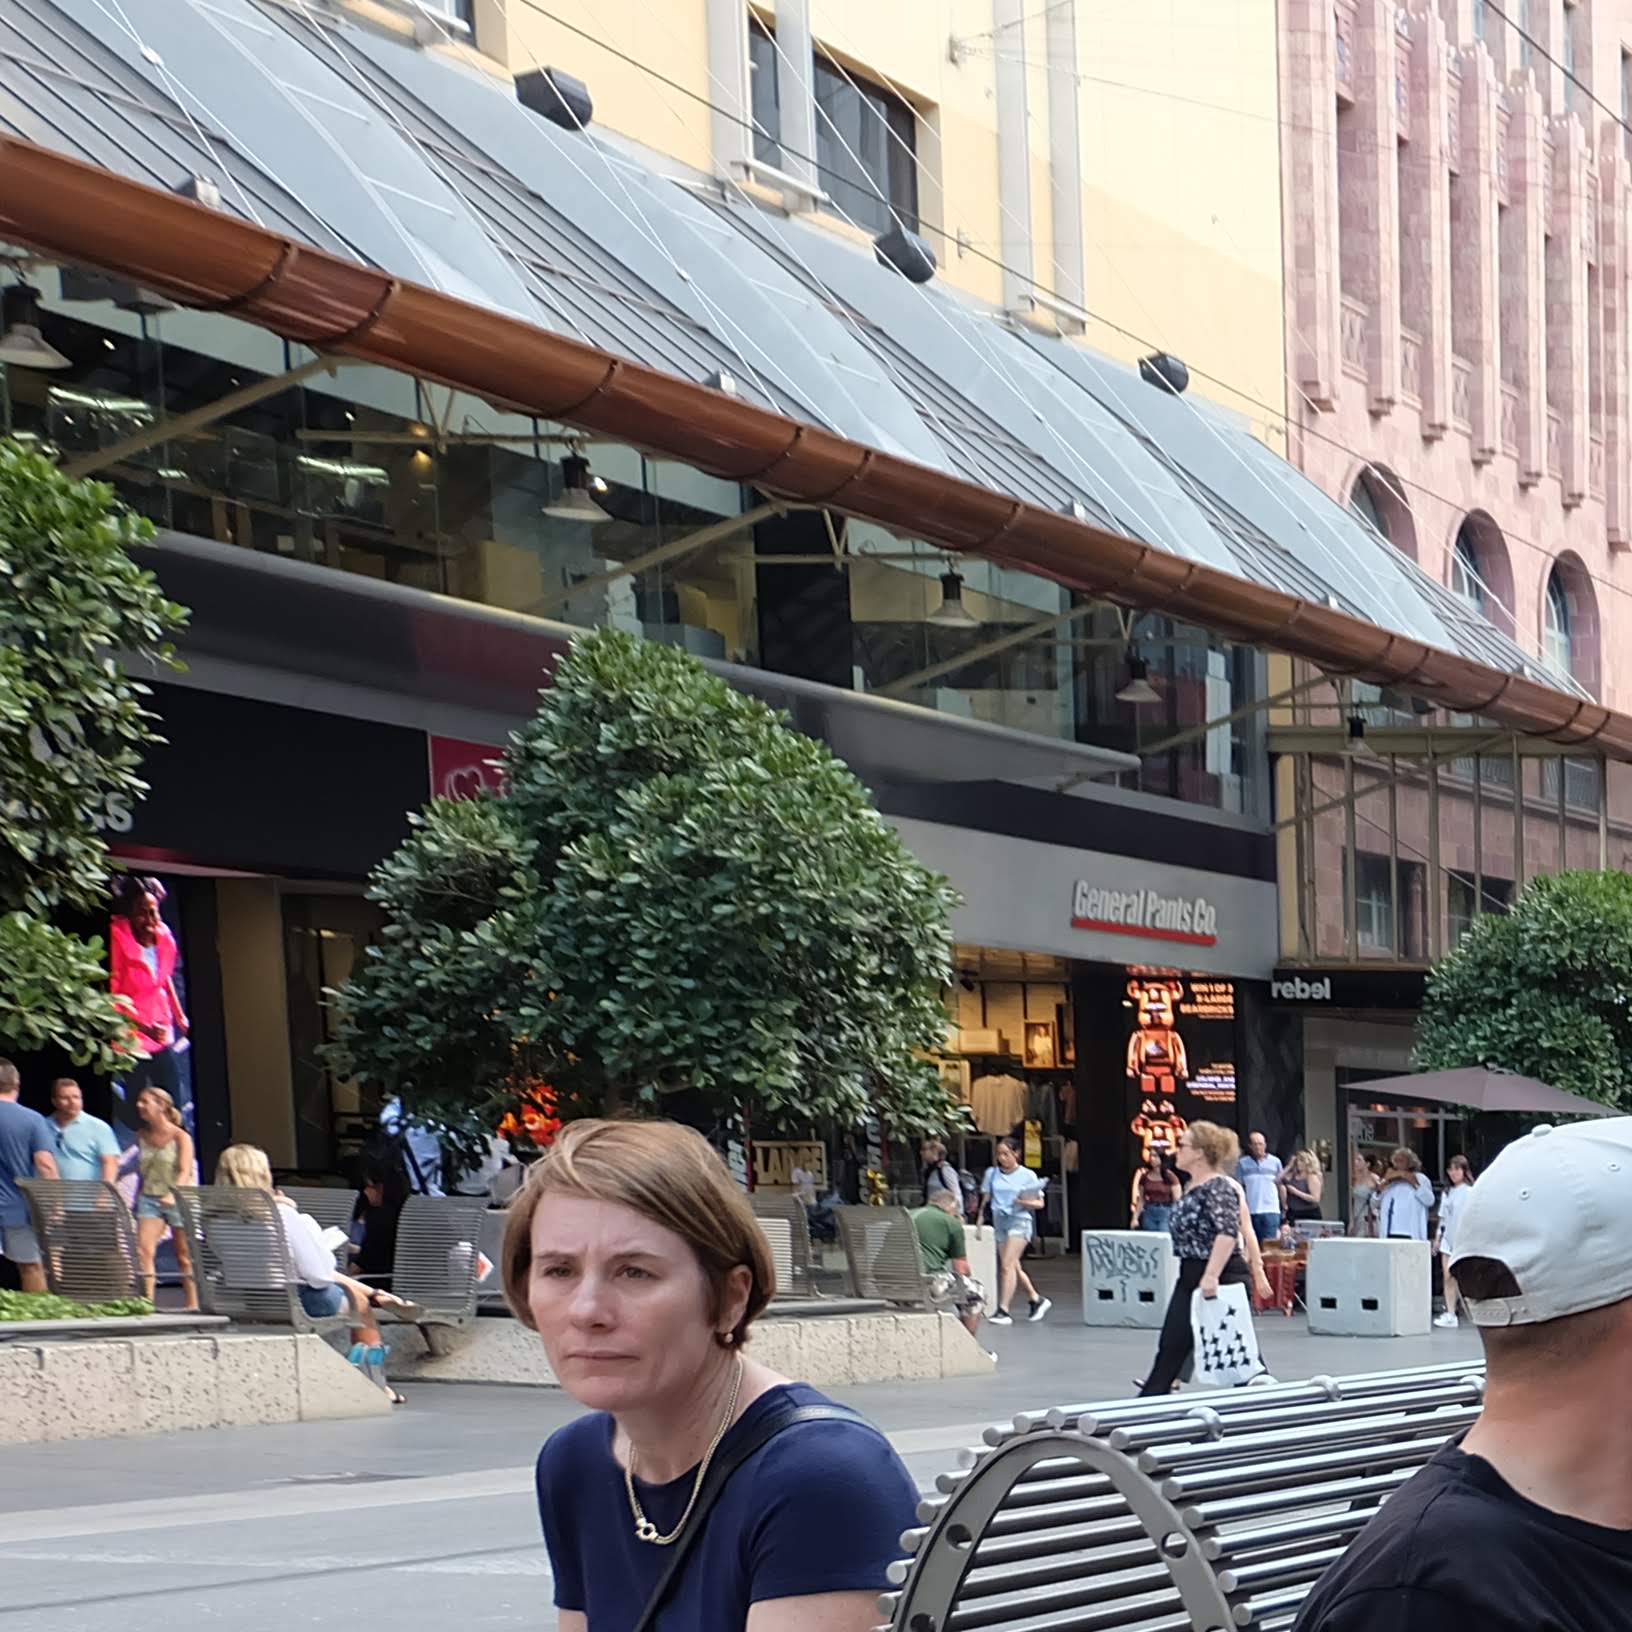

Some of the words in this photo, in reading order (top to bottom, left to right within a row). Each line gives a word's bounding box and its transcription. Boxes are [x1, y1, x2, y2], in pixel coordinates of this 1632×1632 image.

[1074, 879, 1144, 926] General
[1146, 890, 1192, 933] Pants
[1193, 898, 1218, 936] Co.
[1271, 976, 1332, 1000] rebel
